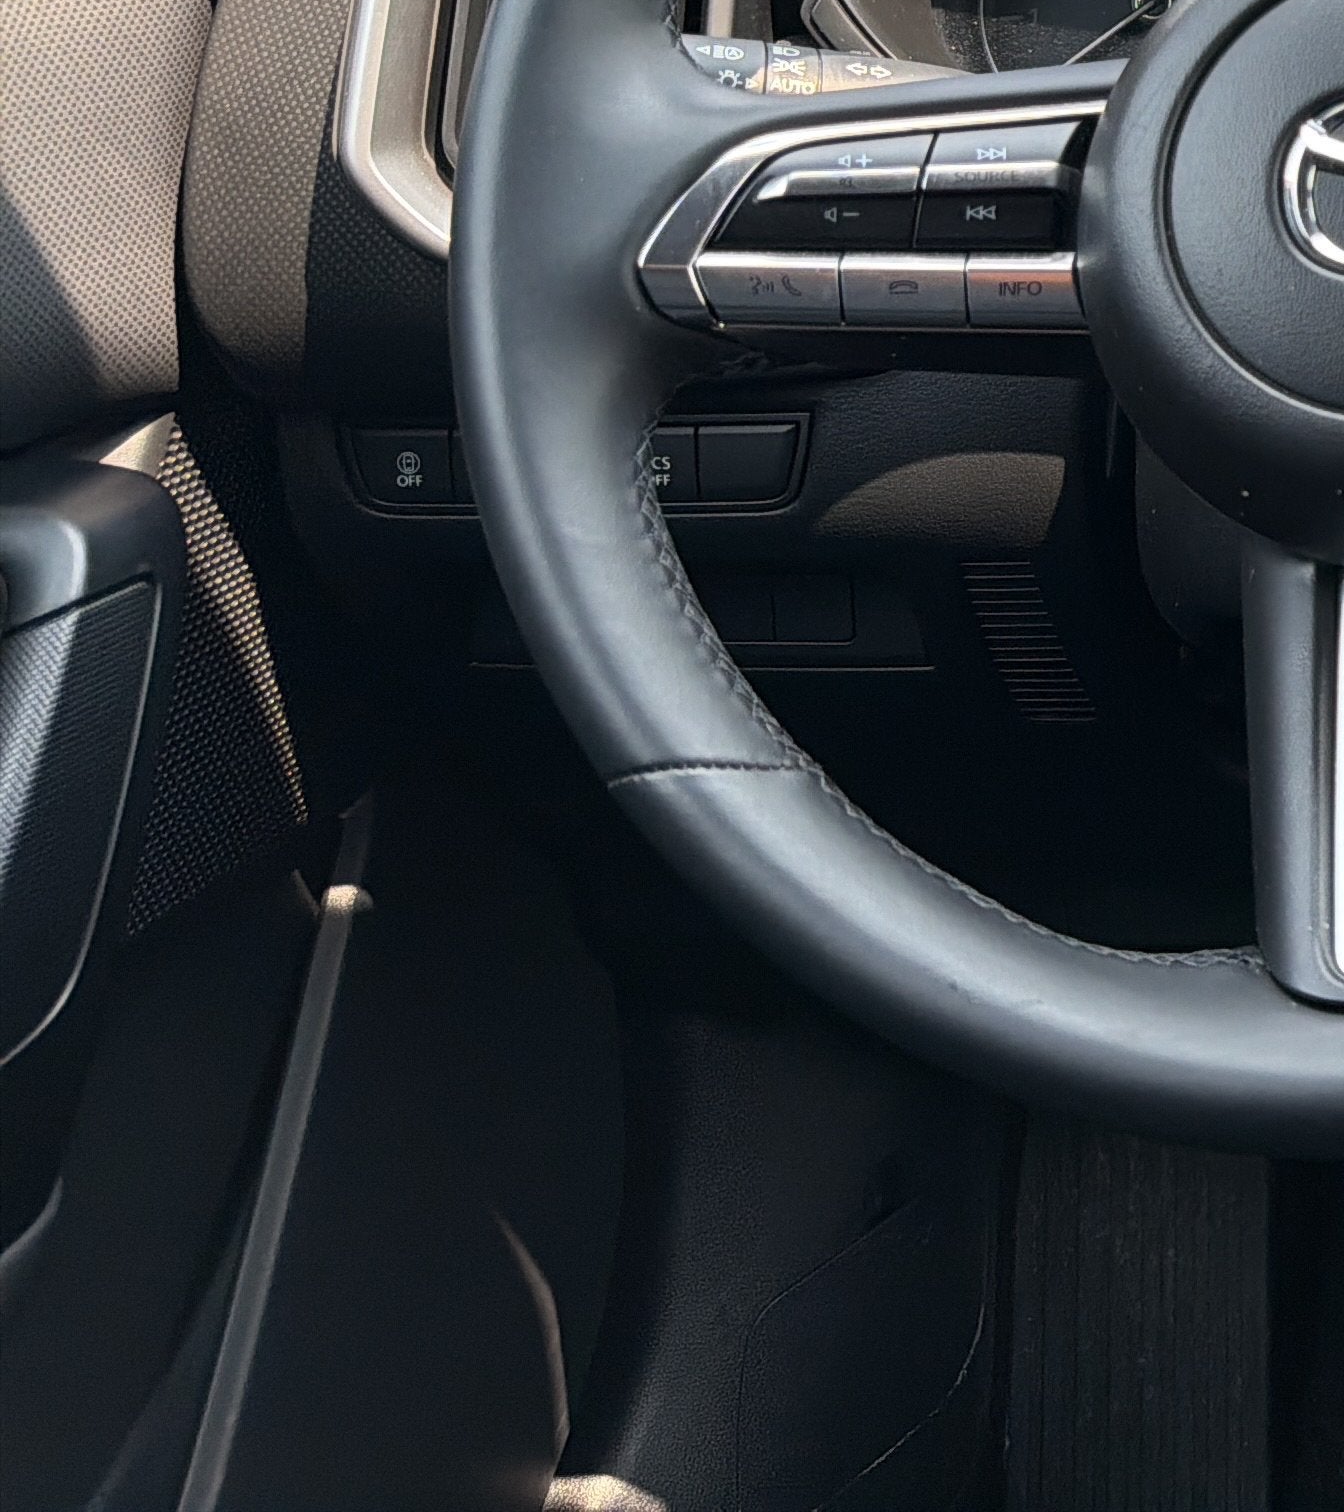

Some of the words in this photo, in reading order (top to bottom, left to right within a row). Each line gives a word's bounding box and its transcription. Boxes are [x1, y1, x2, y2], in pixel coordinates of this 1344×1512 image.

[770, 76, 818, 95] AUTO
[953, 168, 1022, 184] SOURCE
[998, 280, 1044, 297] INFO
[651, 456, 671, 470] CS
[396, 474, 424, 488] OFF
[653, 473, 671, 487] FF
